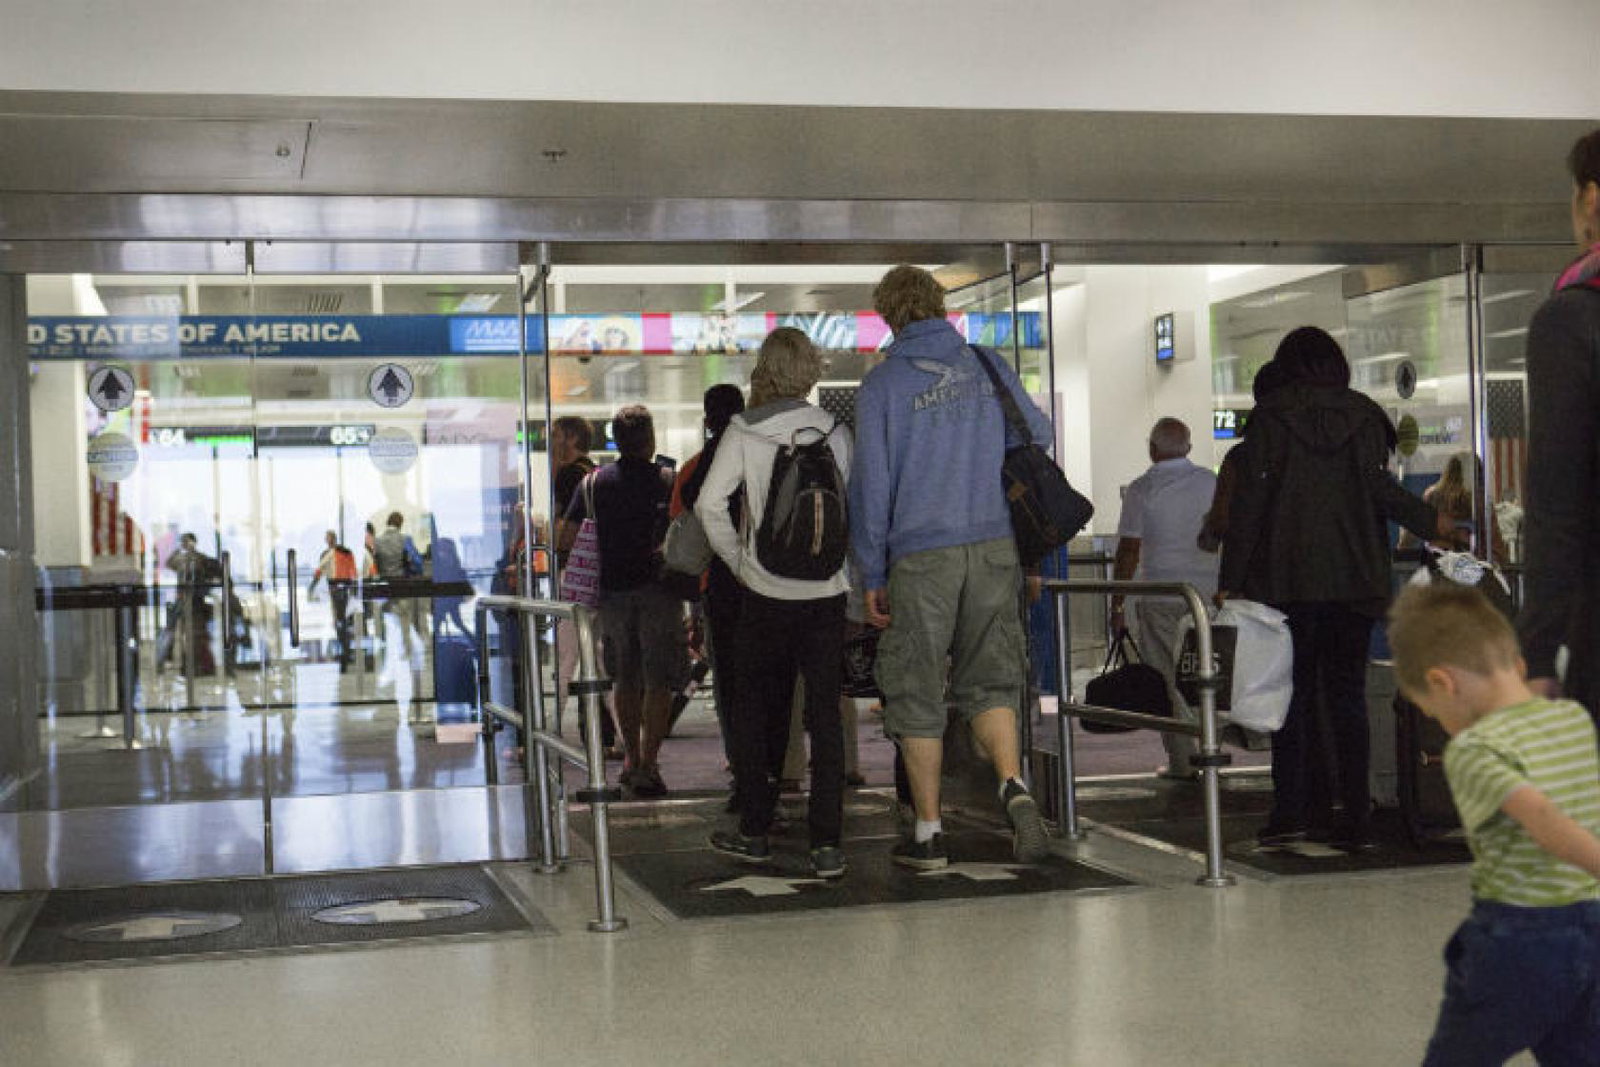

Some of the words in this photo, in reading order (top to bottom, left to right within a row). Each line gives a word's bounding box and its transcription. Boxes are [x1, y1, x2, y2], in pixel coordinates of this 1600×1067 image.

[54, 323, 169, 344] STATES
[178, 323, 216, 343] OF
[224, 322, 361, 342] AMERICA
[1215, 410, 1236, 428] 72
